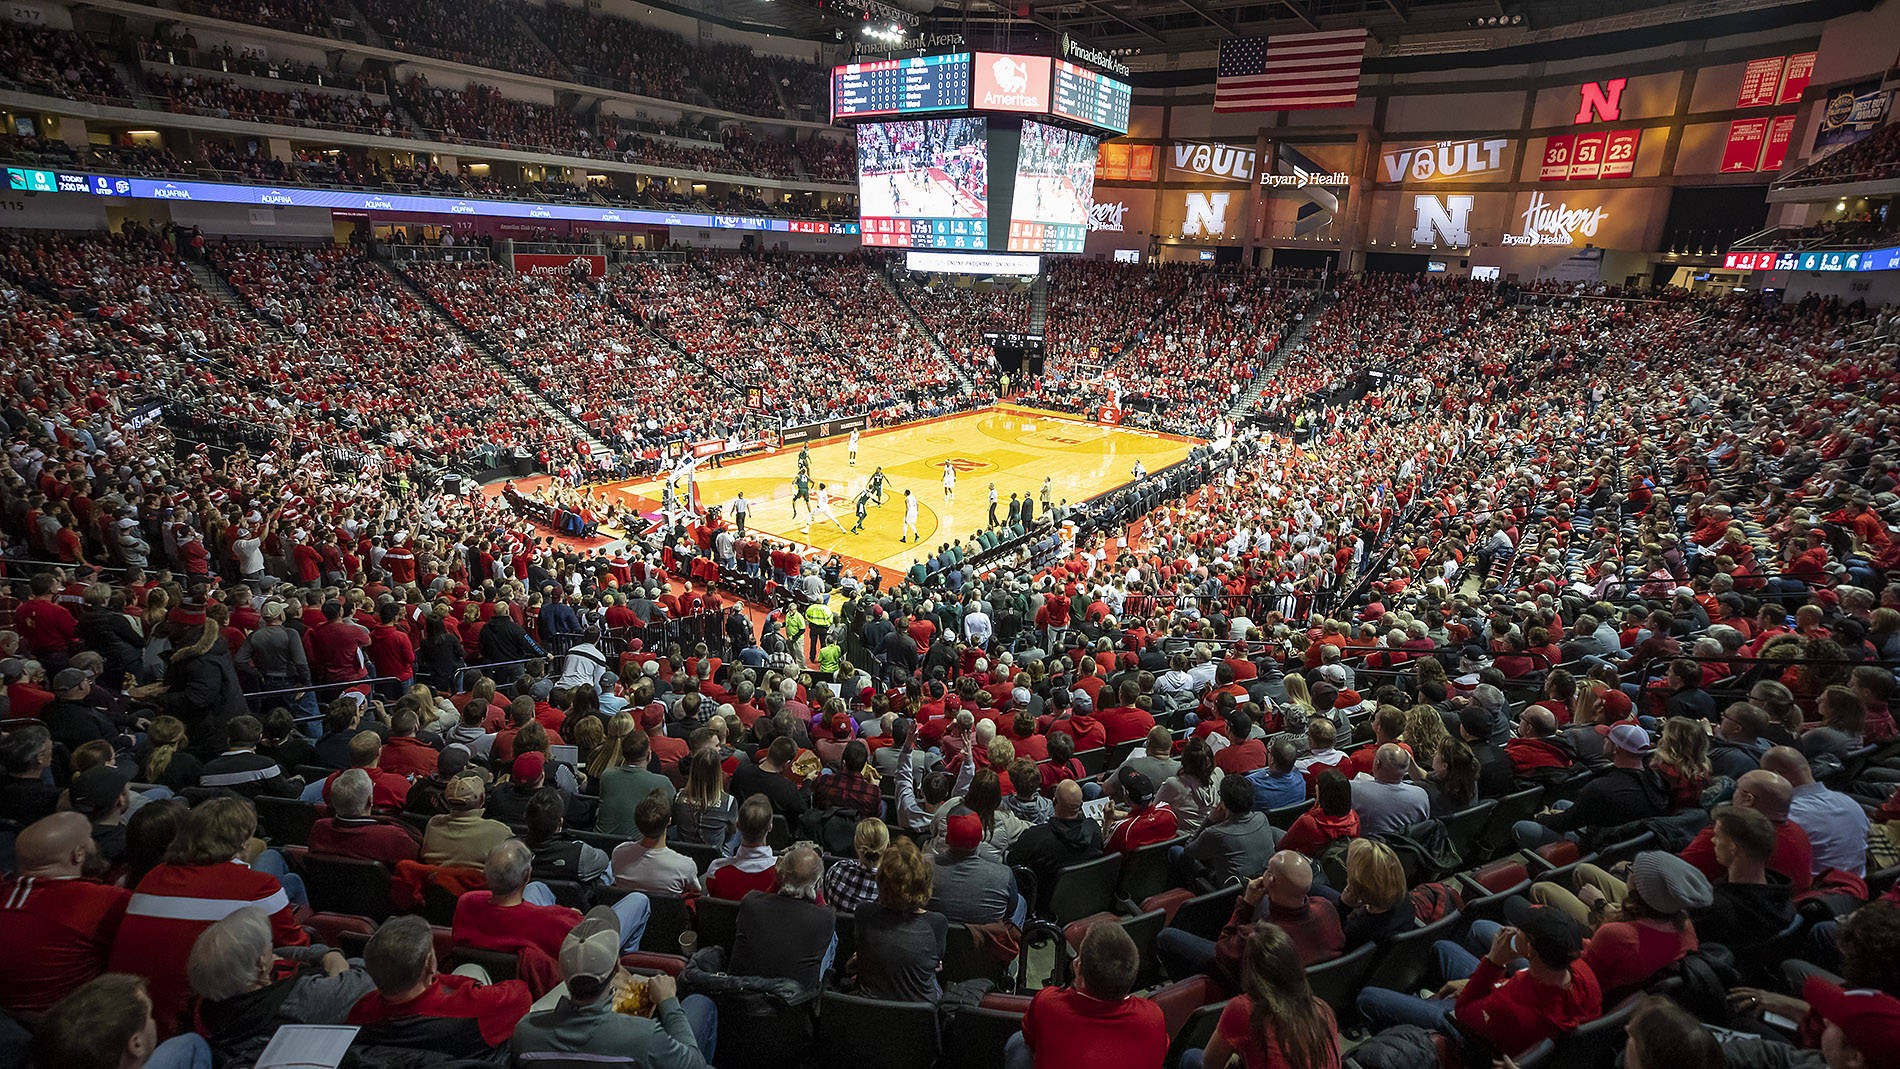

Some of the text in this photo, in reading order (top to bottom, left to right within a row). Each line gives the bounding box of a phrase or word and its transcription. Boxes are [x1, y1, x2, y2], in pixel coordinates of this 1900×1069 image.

[928, 33, 961, 46] Arena
[1113, 58, 1130, 76] Arena
[984, 91, 1038, 106] Ameritas
[1574, 78, 1628, 124] N
[1547, 148, 1567, 163] 30
[1578, 146, 1596, 161] 51
[1609, 144, 1632, 160] 23
[35, 172, 45, 183] 0
[98, 178, 107, 188] 0
[1260, 172, 1349, 188] Bryan Health
[59, 182, 90, 192] 7:00 PM
[154, 188, 192, 199] AQUAFINA
[261, 194, 294, 204] AQUAFINA
[1182, 192, 1230, 235] N
[1522, 189, 1608, 243] Huskers
[818, 222, 825, 232] 2
[899, 222, 906, 232] 2
[938, 222, 945, 233] 6
[1411, 194, 1474, 248] N
[1502, 233, 1570, 247] Bryan Health
[1760, 255, 1771, 268] 2
[1775, 259, 1799, 270] 17:51
[1806, 255, 1815, 268] 6
[1831, 255, 1839, 265] 0
[531, 264, 570, 274] Amerita
[749, 396, 760, 407] 20
[820, 423, 829, 437] N
